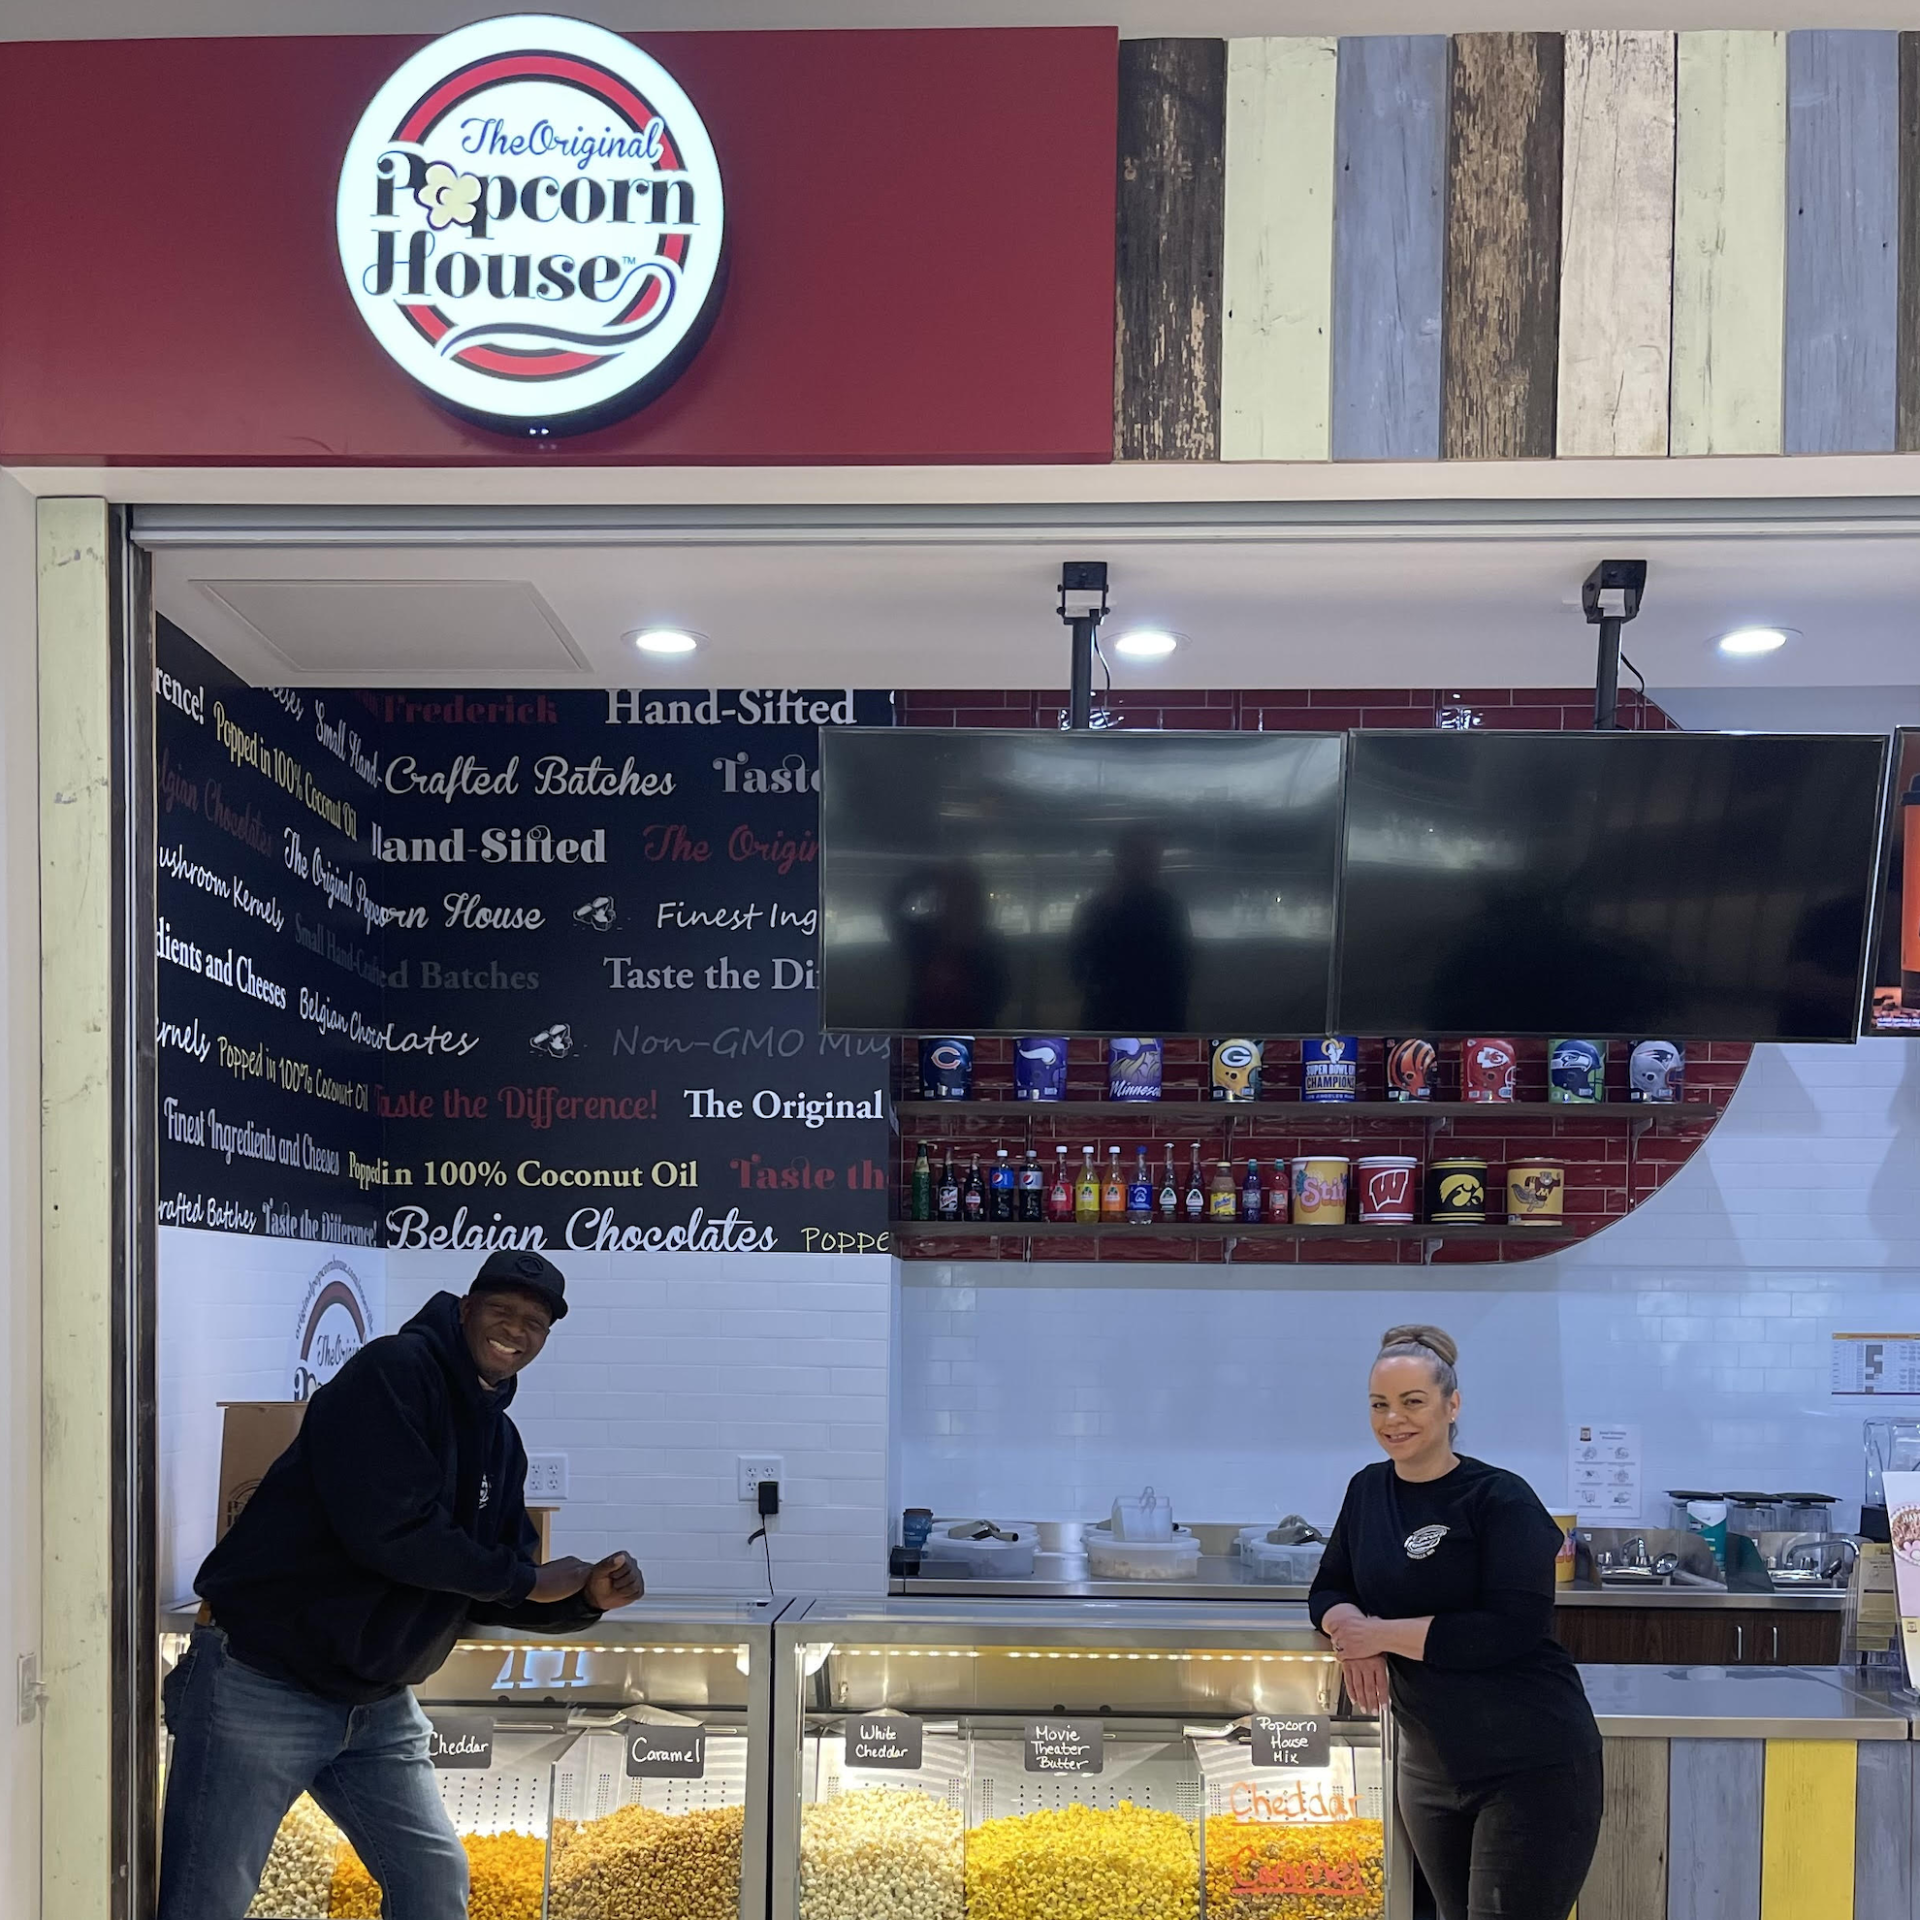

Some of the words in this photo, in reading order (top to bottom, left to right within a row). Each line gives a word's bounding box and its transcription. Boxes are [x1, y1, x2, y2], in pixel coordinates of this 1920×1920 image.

[362, 228, 622, 303] House
[604, 689, 857, 726] Hand-Sifted
[315, 699, 346, 762] Small
[534, 755, 676, 797] Batches
[213, 701, 258, 768] Popped
[260, 736, 271, 779] in
[274, 748, 303, 801] 100%
[305, 772, 342, 830] Coconut
[343, 802, 358, 842] Oil
[642, 824, 712, 862] The
[284, 826, 309, 880] The
[311, 847, 354, 910] Original
[443, 892, 546, 930] House
[233, 875, 285, 933] Kernels
[656, 901, 764, 931] Finest
[770, 903, 819, 936] Ing
[205, 949, 233, 988] and
[236, 955, 286, 1010] Cheeses
[420, 960, 540, 991] Batches
[603, 956, 693, 990] Taste
[704, 956, 760, 990] the
[771, 958, 820, 990] Di
[299, 987, 349, 1035] Belgian
[349, 1010, 480, 1056] Chocolates
[612, 1025, 805, 1059] Non-GMO
[217, 1036, 264, 1081] Popped
[266, 1048, 276, 1083] in
[279, 1057, 313, 1094] 100%
[315, 1069, 353, 1108] Coconut
[355, 1084, 368, 1112] Oil
[1306, 1064, 1327, 1076] SUPER
[443, 1087, 489, 1119] the
[498, 1086, 658, 1130] Difference!
[683, 1088, 743, 1120] The
[752, 1089, 884, 1129] Original
[163, 1096, 205, 1146] Finest
[207, 1107, 276, 1165] Ingredients
[278, 1133, 301, 1168] and
[302, 1132, 340, 1176] Cheeses
[424, 1160, 508, 1187] 100%
[516, 1160, 644, 1188] Coconut
[651, 1160, 699, 1188] Oil
[729, 1153, 836, 1190] Taste
[847, 1158, 889, 1190] th
[207, 1197, 258, 1233] Batches
[262, 1197, 298, 1238] Taste
[300, 1208, 319, 1241] the
[386, 1206, 547, 1251] Belgian
[565, 1207, 779, 1252] Chocolates
[860, 1724, 898, 1741] White
[1035, 1724, 1081, 1743] Movie
[1256, 1716, 1318, 1734] Popcorn
[1270, 1735, 1310, 1749] House
[631, 1736, 701, 1763] Caramel
[855, 1744, 909, 1759] Cheddar
[1030, 1740, 1091, 1757] Theater
[1035, 1756, 1090, 1771] Butter
[1229, 1781, 1366, 1821] Cheddar
[1231, 1845, 1363, 1889] Caramel
